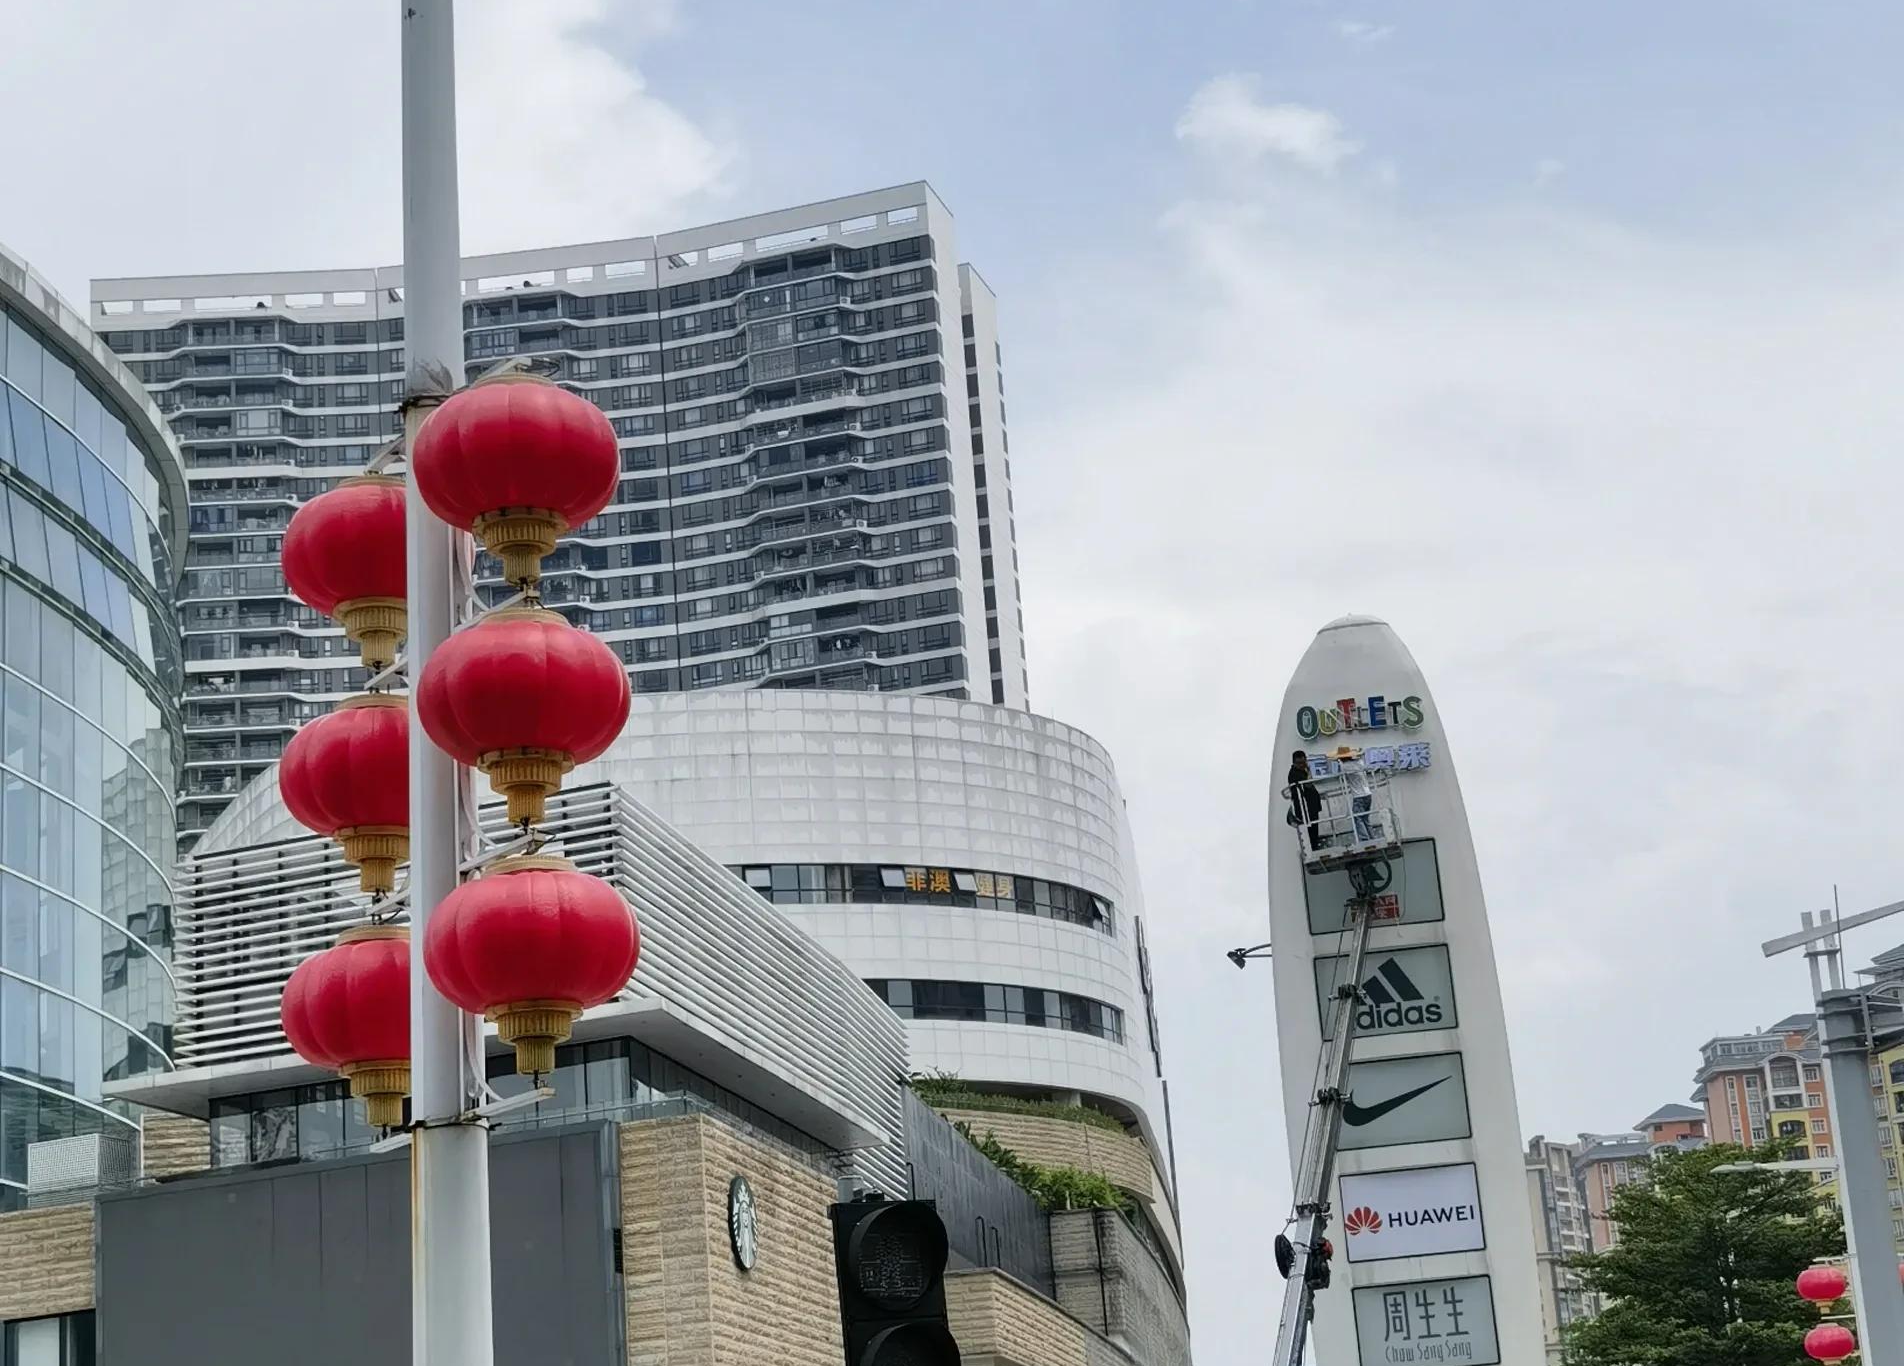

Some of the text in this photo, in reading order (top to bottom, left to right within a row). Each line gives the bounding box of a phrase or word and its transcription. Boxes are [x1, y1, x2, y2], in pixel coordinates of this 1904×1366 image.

[1297, 696, 1424, 741] OUTLETS
[1356, 1002, 1442, 1030] didas
[1388, 1205, 1475, 1228] HUAWEI
[1383, 1287, 1470, 1342] 周生生
[1385, 1339, 1472, 1363] Chow Sang Sang
